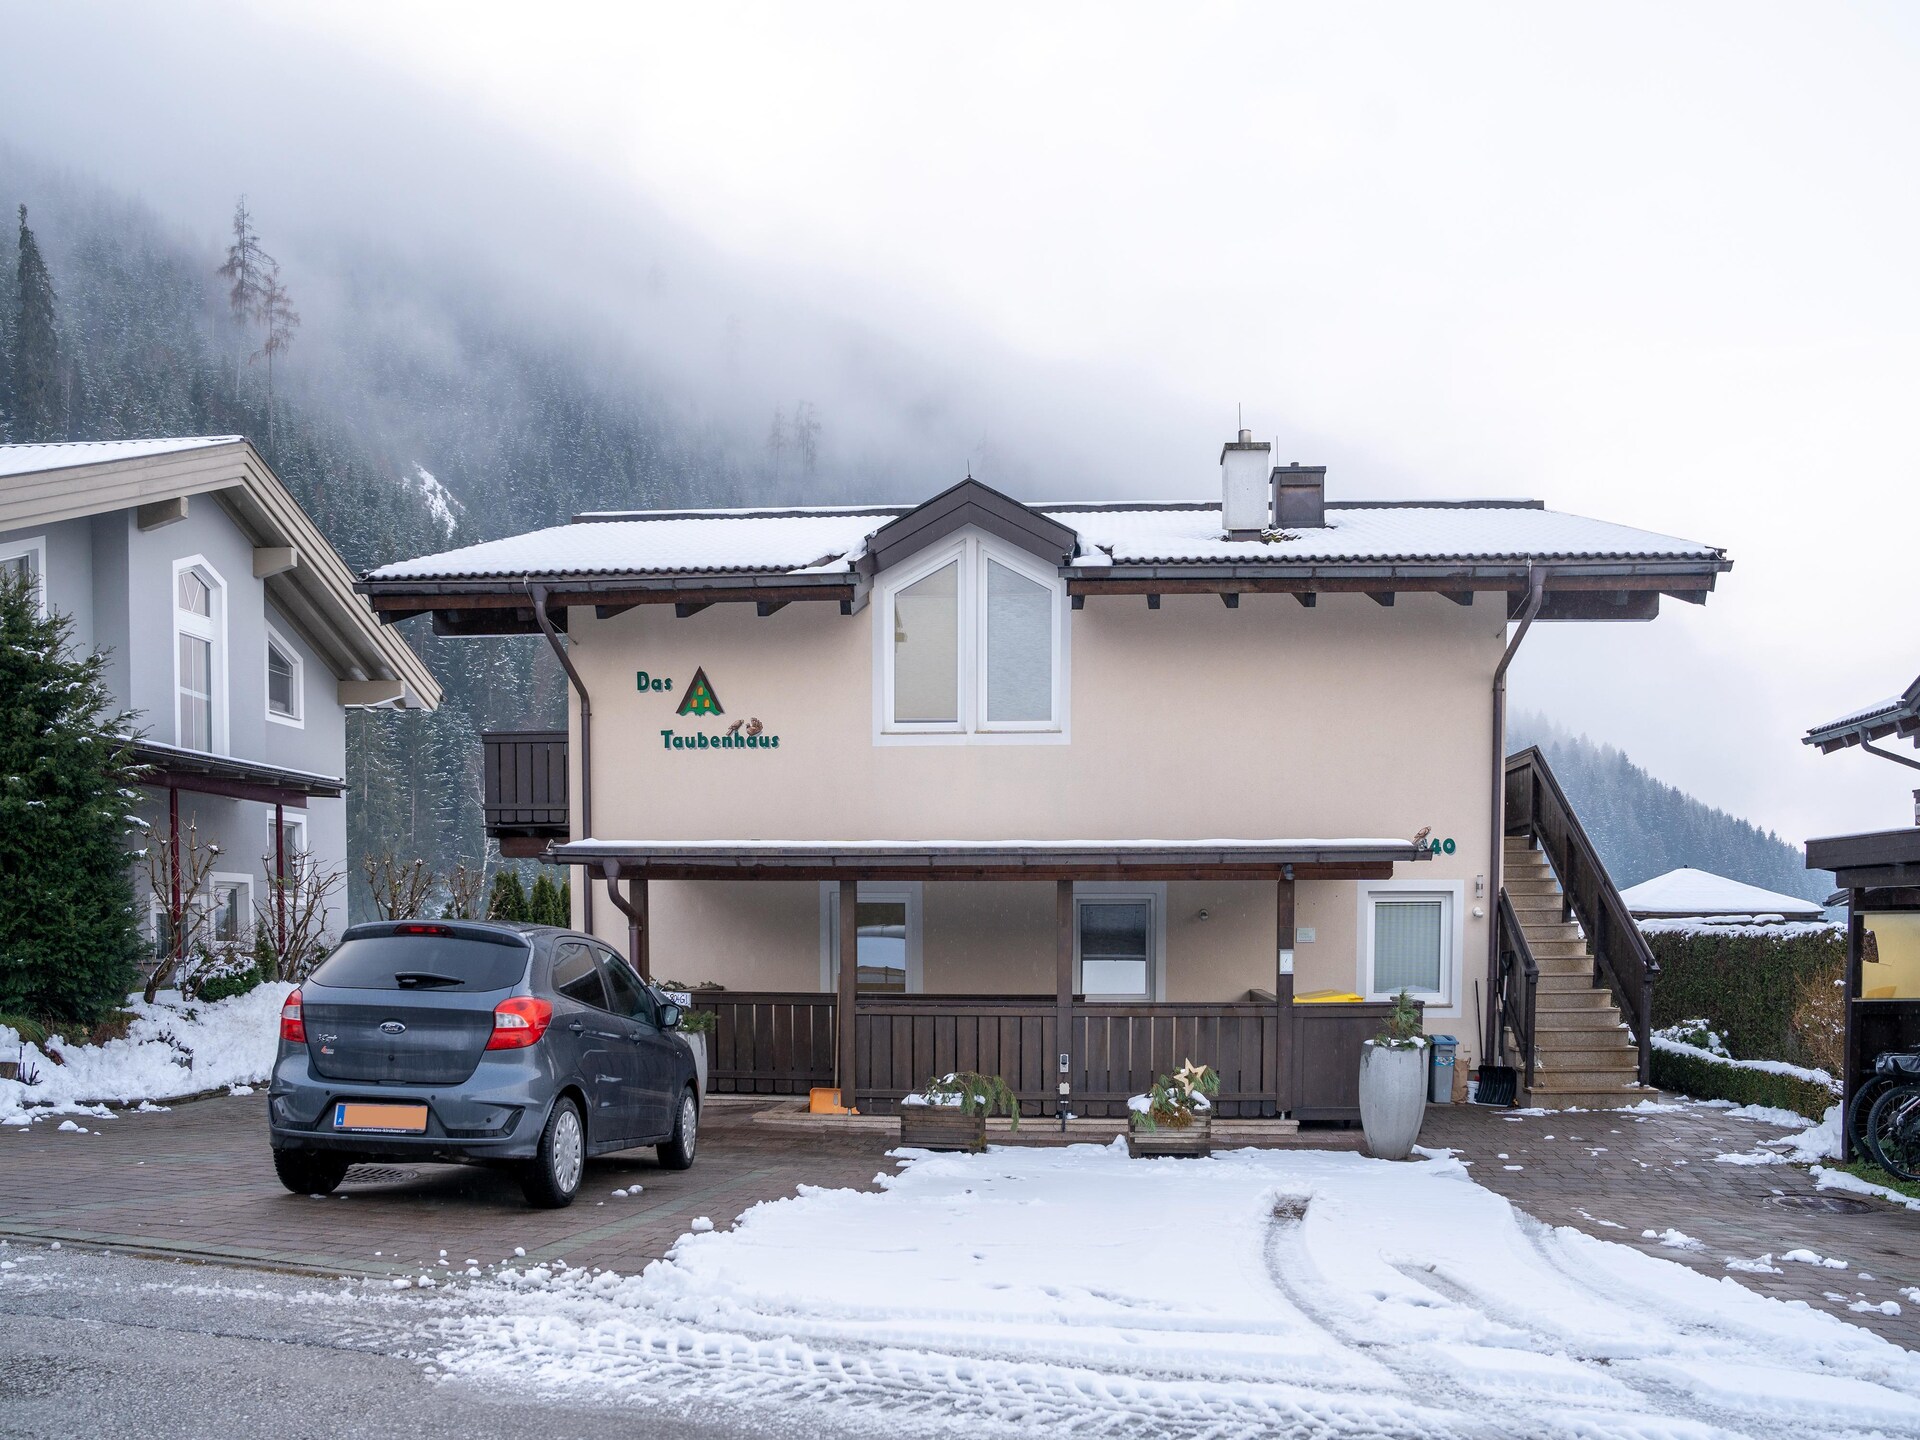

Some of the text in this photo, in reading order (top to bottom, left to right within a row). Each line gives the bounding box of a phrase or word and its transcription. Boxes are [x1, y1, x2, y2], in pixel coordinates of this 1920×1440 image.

[636, 671, 673, 692] Das
[660, 729, 780, 750] Taubenhaus
[1430, 838, 1456, 855] 40
